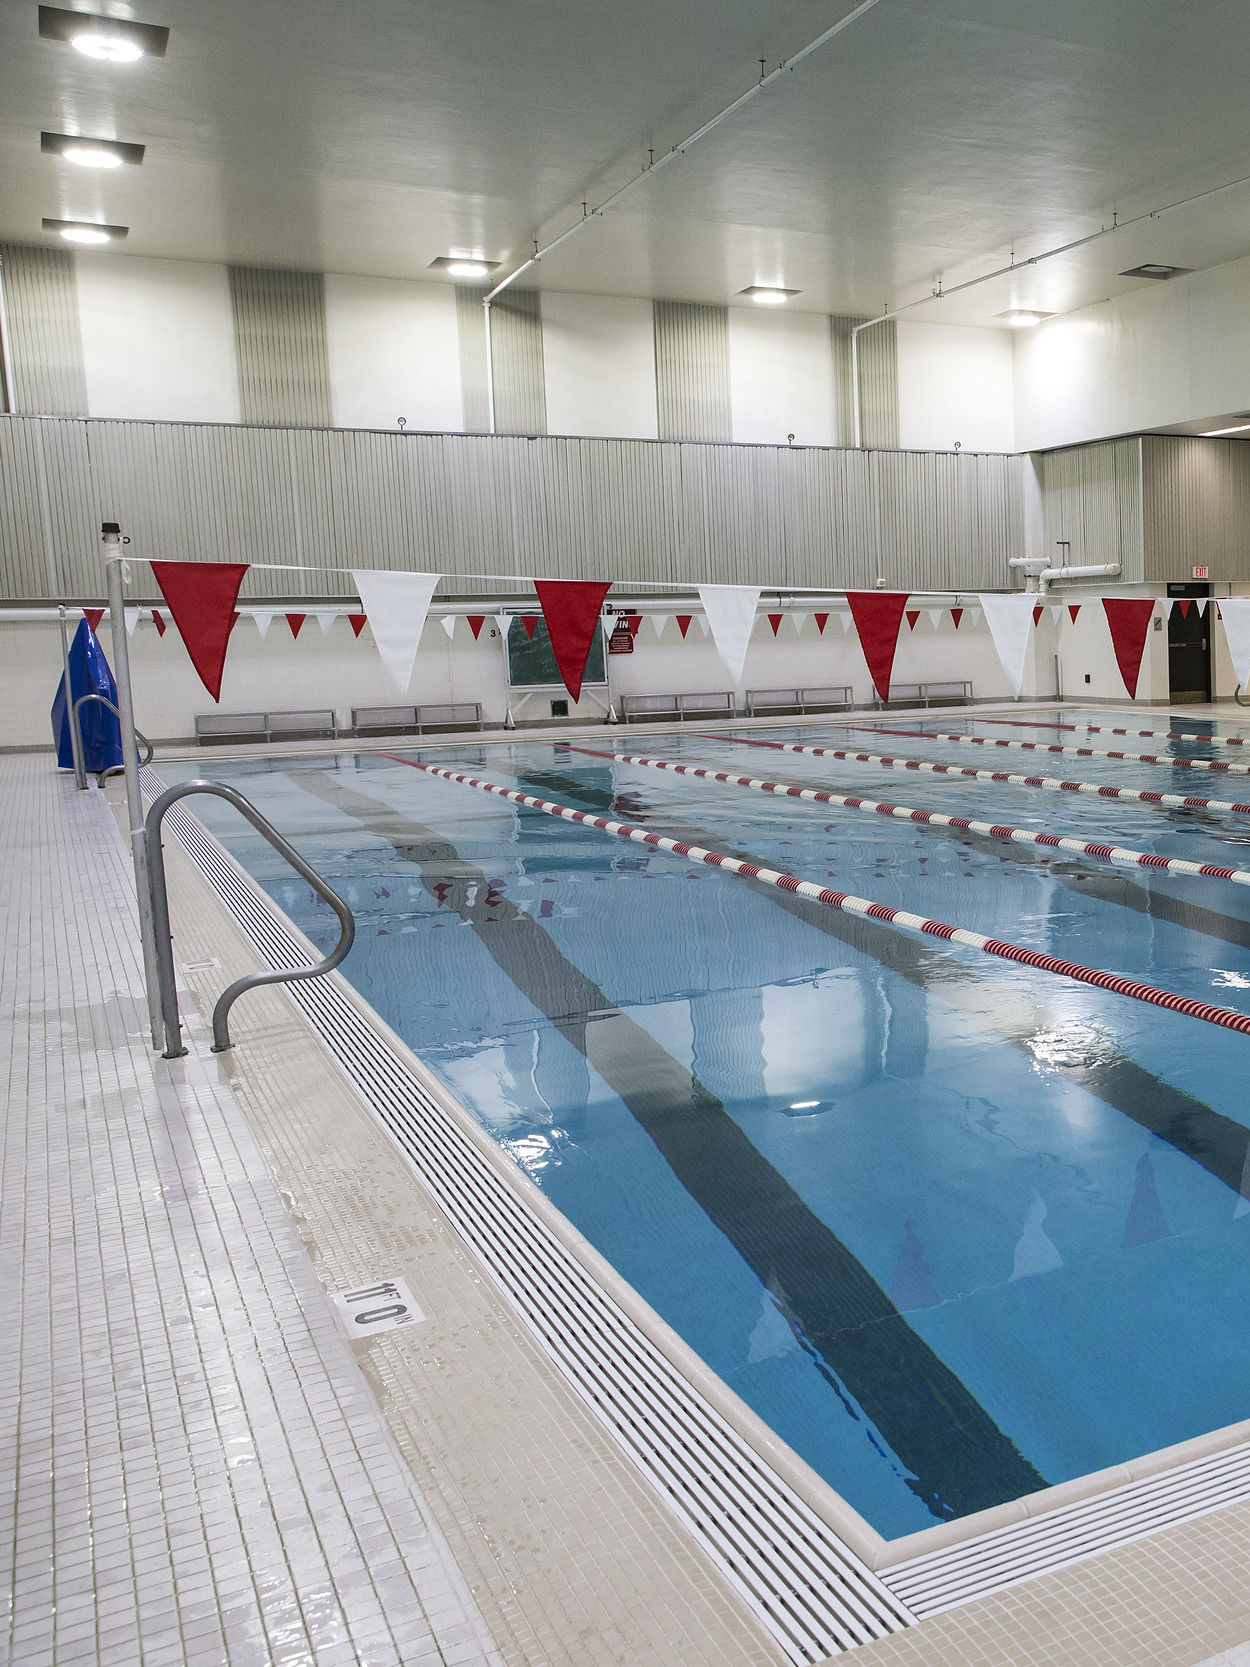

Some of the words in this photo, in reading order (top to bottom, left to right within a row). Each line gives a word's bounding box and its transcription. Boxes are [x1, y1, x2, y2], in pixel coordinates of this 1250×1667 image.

[1195, 567, 1207, 577] EXIT
[490, 629, 496, 638] 3
[343, 1282, 398, 1303] 11
